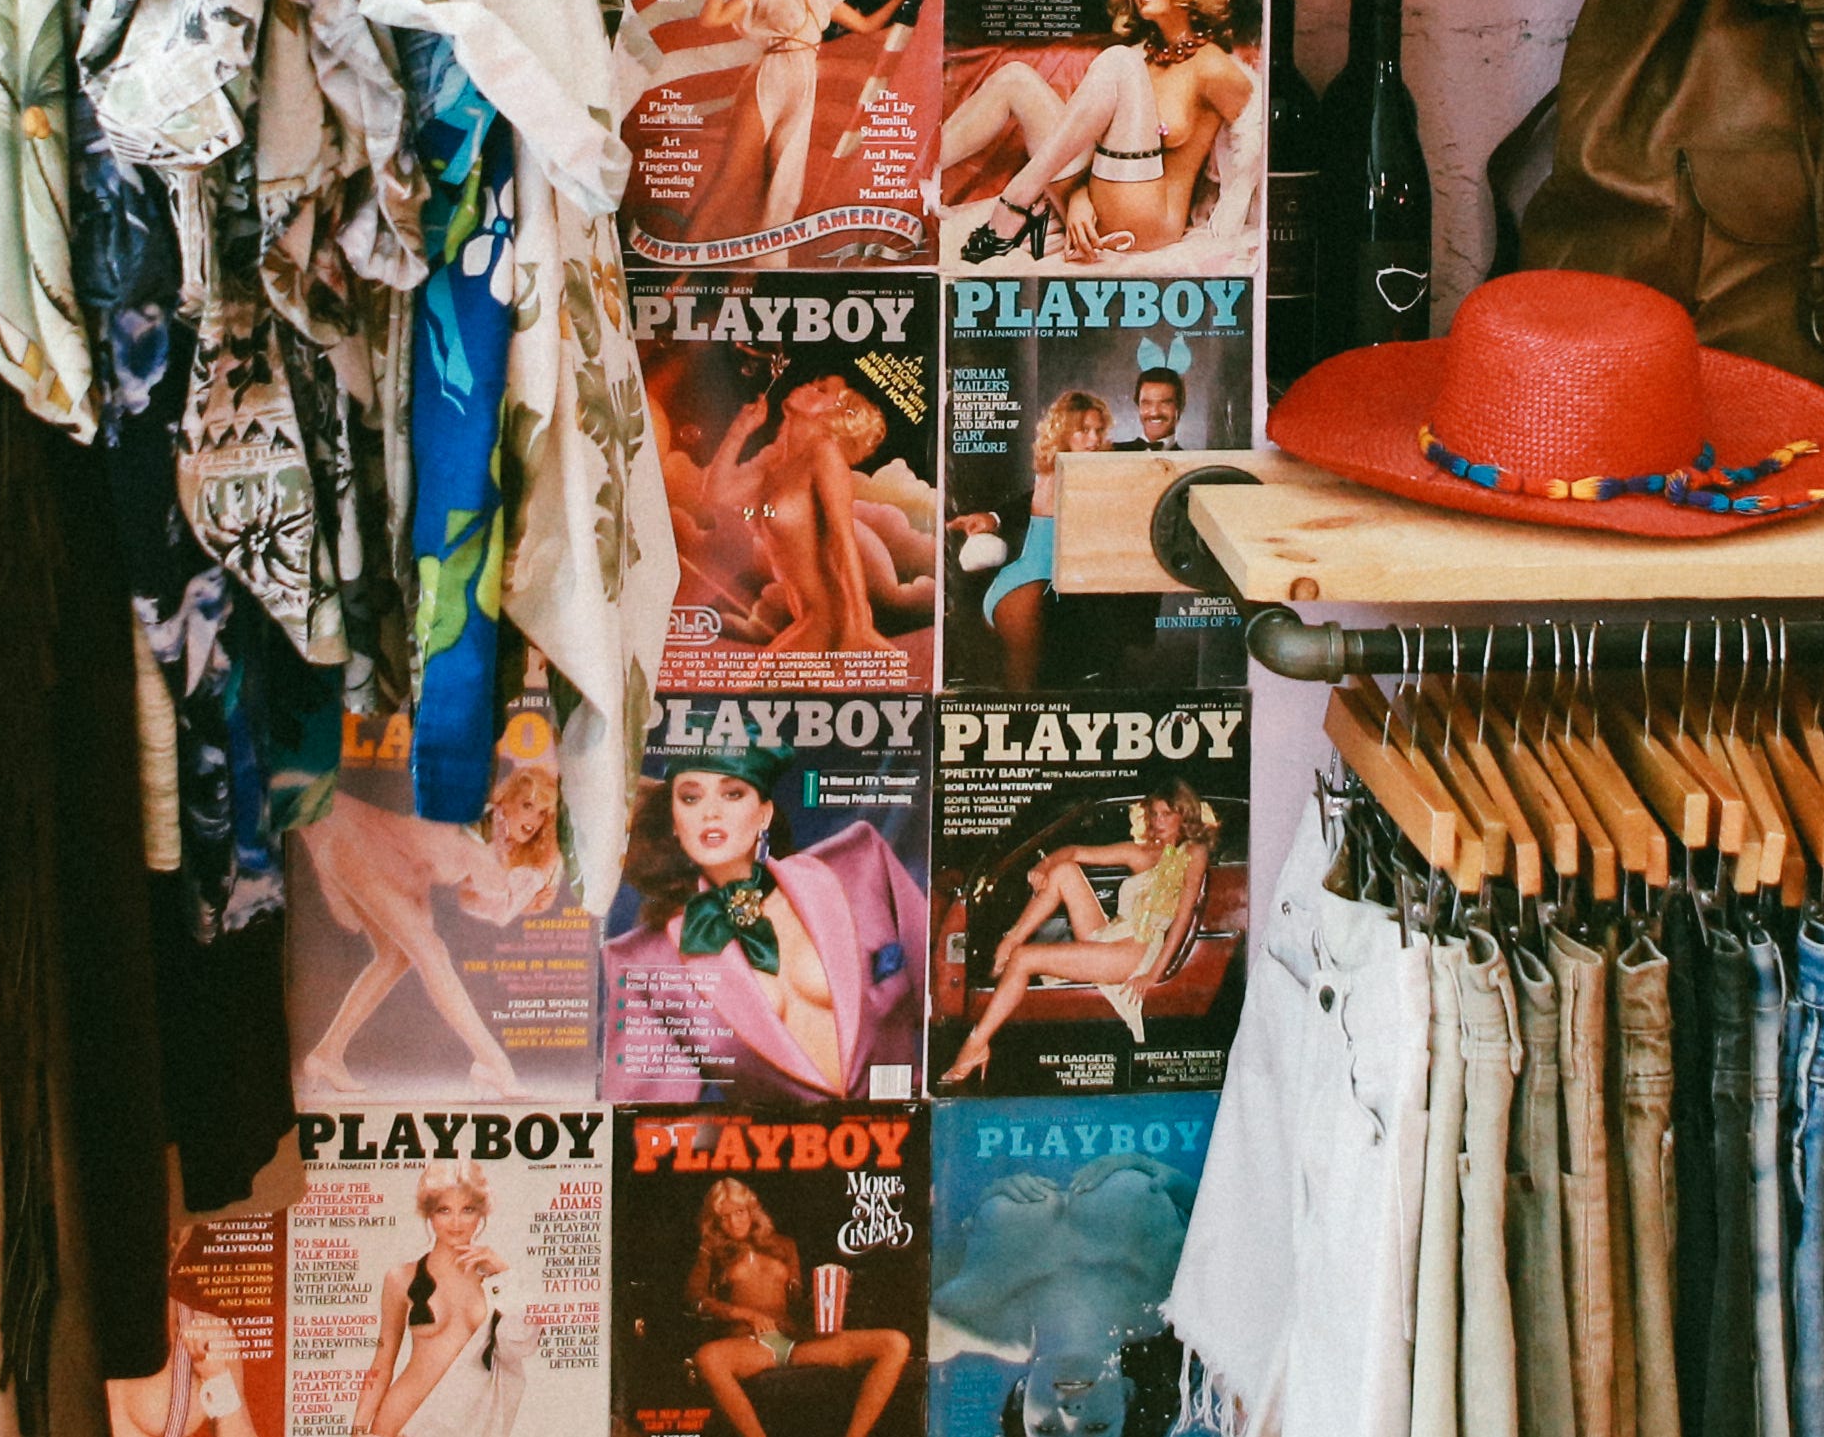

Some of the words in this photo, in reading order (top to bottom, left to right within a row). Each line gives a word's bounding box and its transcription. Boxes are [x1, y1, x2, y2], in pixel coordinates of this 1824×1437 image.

[871, 115, 907, 125] Tomlin
[861, 127, 898, 138] Stands
[902, 128, 916, 139] Up
[662, 136, 680, 146] Art
[645, 149, 698, 159] Buchwald
[645, 176, 694, 186] Founding
[859, 189, 917, 199] Mansfield!
[633, 232, 700, 262] HAPPY
[706, 222, 812, 260] BIRTHDAY,
[817, 208, 920, 235] AMERICA!
[954, 280, 1245, 328] PLAYBOY
[632, 296, 914, 342] PLAYBOY
[954, 330, 1031, 338] ENTERTAINMENT
[1034, 330, 1054, 338] FOR
[1057, 329, 1078, 337] MEN
[884, 353, 926, 394] EXPLOSIVE
[954, 368, 1006, 379] NORMAN
[854, 357, 890, 390] JIMMY
[886, 387, 924, 426] HOFFA!
[954, 381, 1009, 392] MAILER'S
[954, 431, 985, 442] GARY
[953, 442, 1007, 453] GILMORE
[1155, 617, 1206, 628] BUNNIES
[1210, 617, 1225, 627] OF
[941, 704, 1023, 712] ENTERTAINMENT
[941, 711, 1242, 761] PLAYBOY
[940, 768, 995, 778] "PRETTY
[999, 768, 1041, 778] BABY"
[944, 783, 965, 791] BOB
[967, 783, 999, 791] DYLAN
[1001, 783, 1052, 791] INTERVIEW
[1039, 1055, 1060, 1063] SEX
[1063, 1054, 1117, 1063] GADGETS:
[299, 1113, 603, 1160] PLAYBOY
[976, 1119, 1204, 1158] PLAYBOY
[633, 1122, 910, 1172] PLAYBOY
[560, 1182, 603, 1194] MAUD
[550, 1197, 602, 1209] ADAMS
[529, 1224, 540, 1233] IN
[543, 1224, 551, 1233] A
[554, 1223, 601, 1232] PLAYBOY
[216, 1232, 259, 1241] SCORES
[262, 1232, 273, 1240] IN
[837, 1215, 913, 1255] CINEMA
[203, 1244, 273, 1253] HOLLYWOOD
[526, 1246, 555, 1256] WITH
[559, 1245, 601, 1255] SCENES
[294, 1284, 324, 1293] WITH
[327, 1283, 372, 1293] DONALD
[543, 1279, 601, 1292] TATTOO
[294, 1295, 368, 1304] SUTHERLAND
[242, 1351, 273, 1359] STUFF
[293, 1350, 336, 1359] REPORT
[293, 1404, 332, 1414] CASINO
